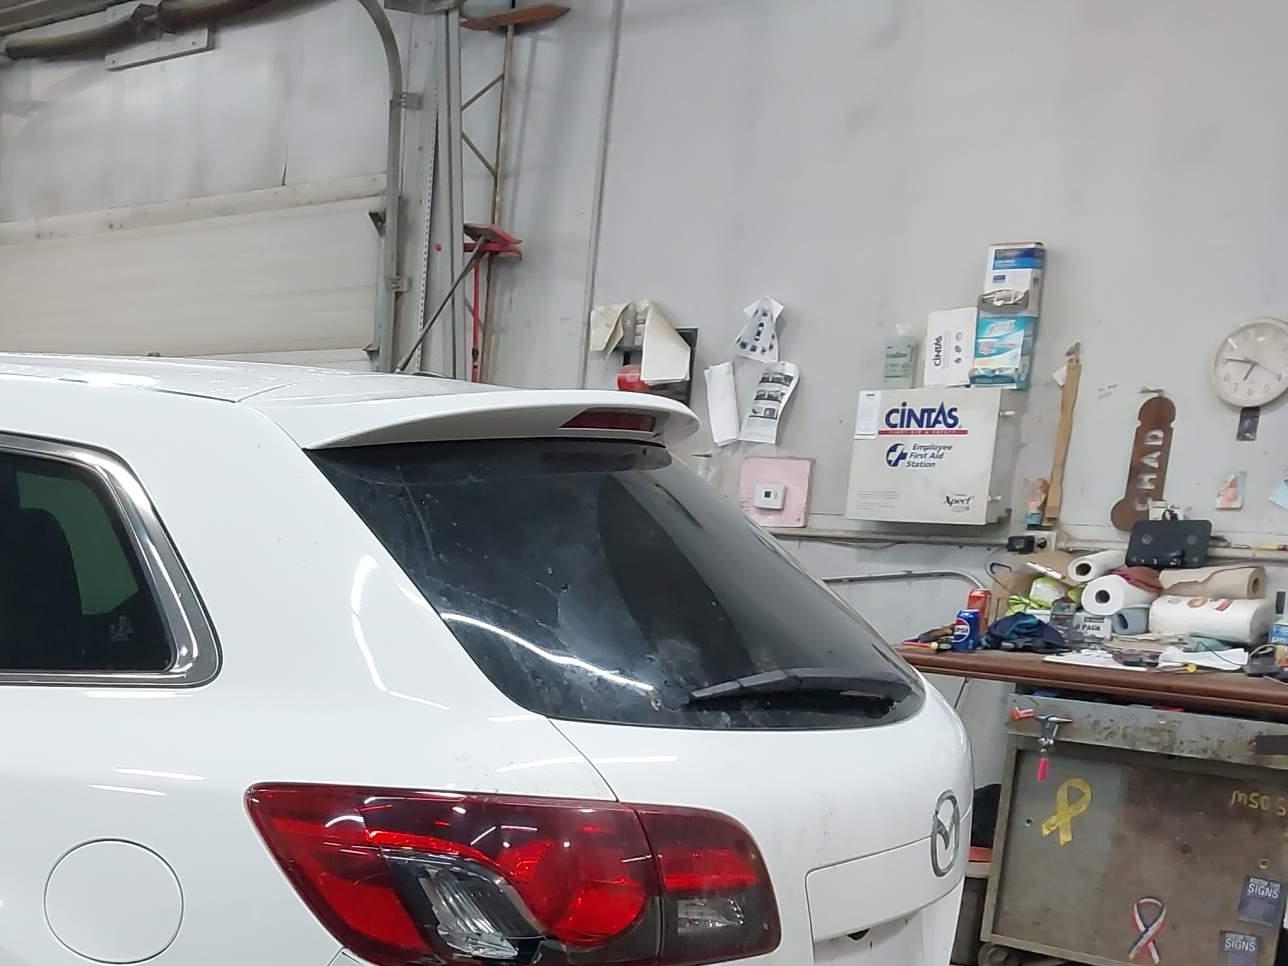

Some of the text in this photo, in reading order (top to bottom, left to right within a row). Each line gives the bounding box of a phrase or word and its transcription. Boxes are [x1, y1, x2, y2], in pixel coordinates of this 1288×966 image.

[885, 401, 960, 429] CINTAS
[912, 443, 953, 454] Employee
[909, 452, 944, 460] First Aid
[906, 460, 936, 468] Station
[1134, 429, 1165, 511] CHAD
[1247, 883, 1279, 899] SIGNS
[1224, 938, 1256, 952] SIGNS
